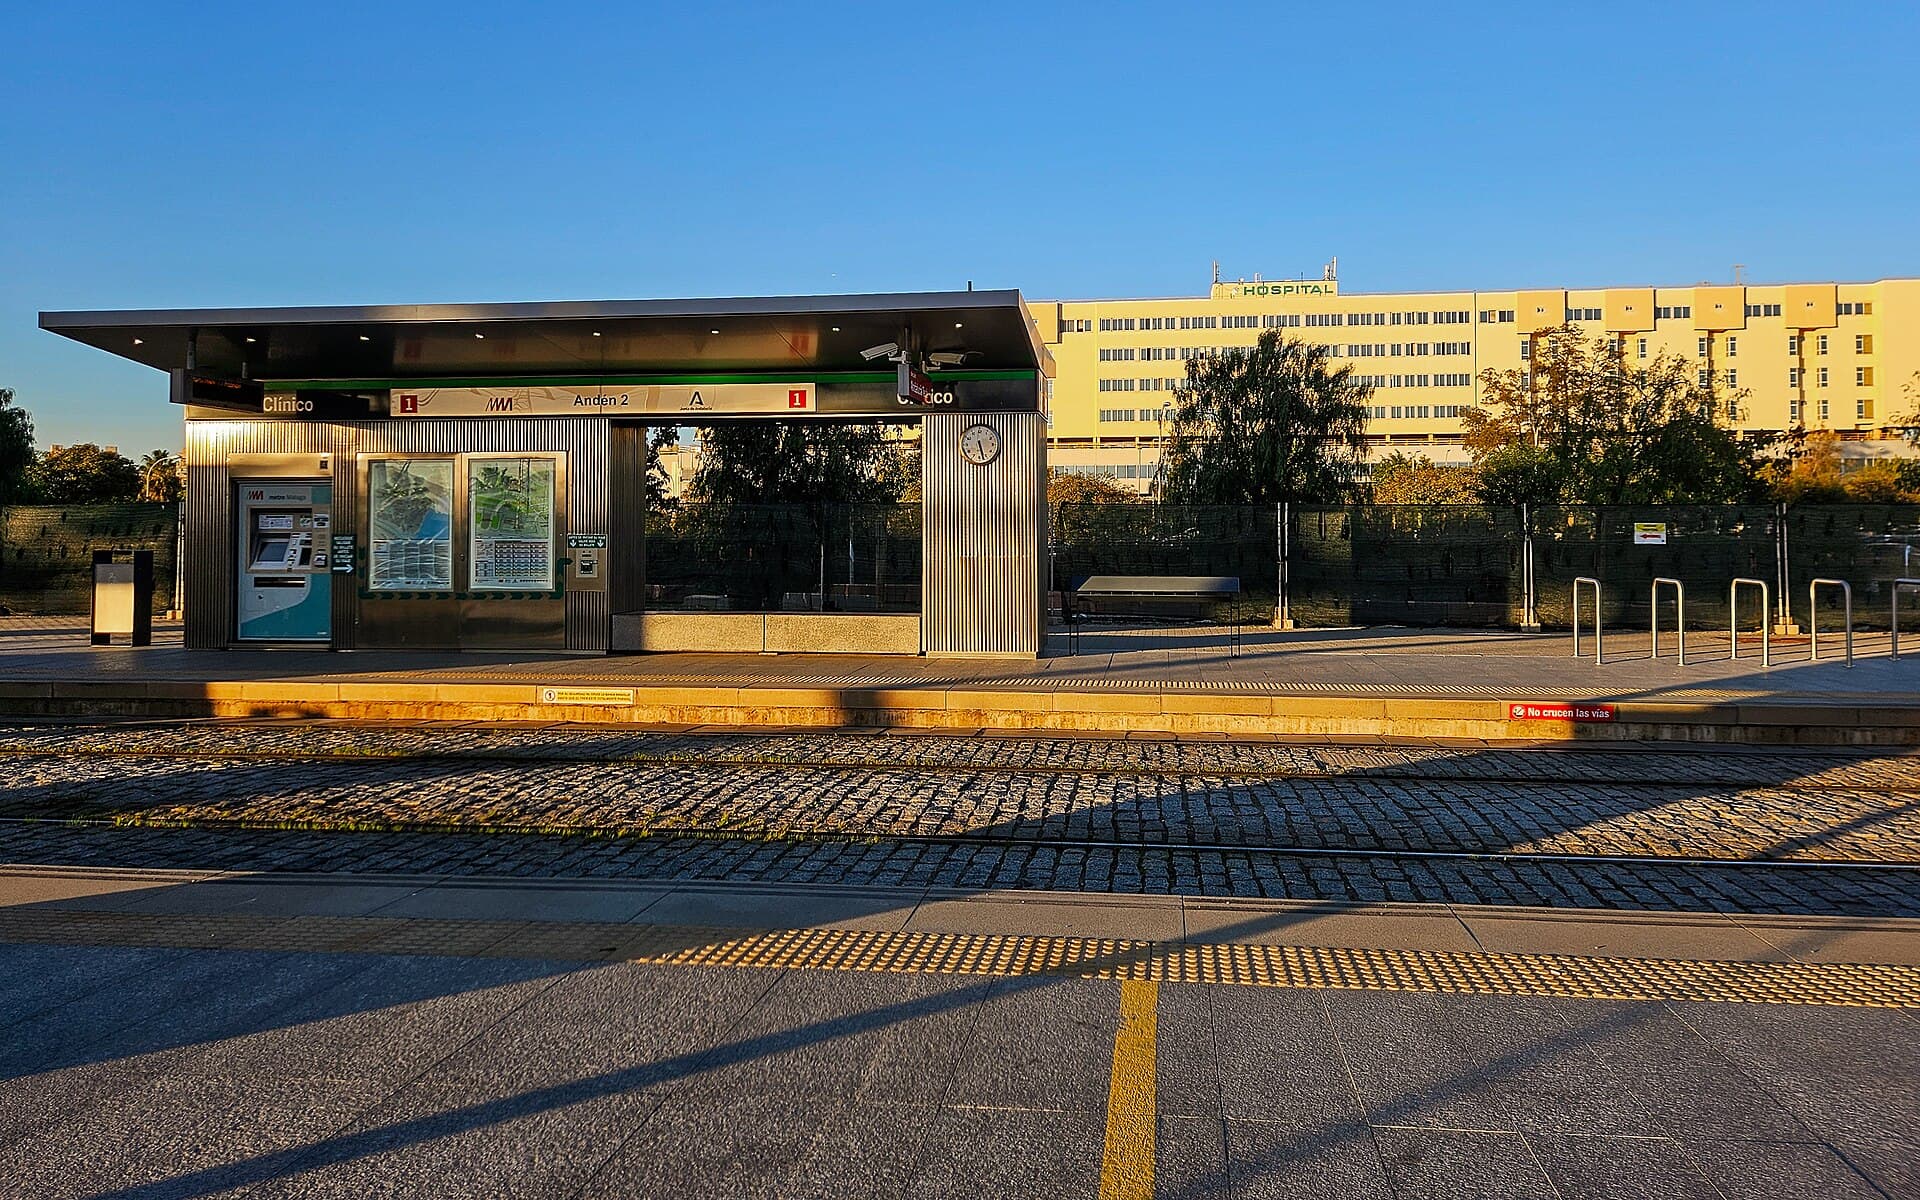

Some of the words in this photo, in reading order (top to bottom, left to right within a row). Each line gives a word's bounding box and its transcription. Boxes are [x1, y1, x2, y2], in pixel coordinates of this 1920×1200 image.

[1243, 284, 1334, 296] HOSPITAL
[263, 395, 314, 412] Clínico
[573, 394, 617, 406] Andén
[620, 394, 629, 406] 2
[1527, 707, 1541, 718] No
[1542, 709, 1574, 718] crucen
[1576, 708, 1590, 718] las
[1592, 708, 1610, 719] vías
